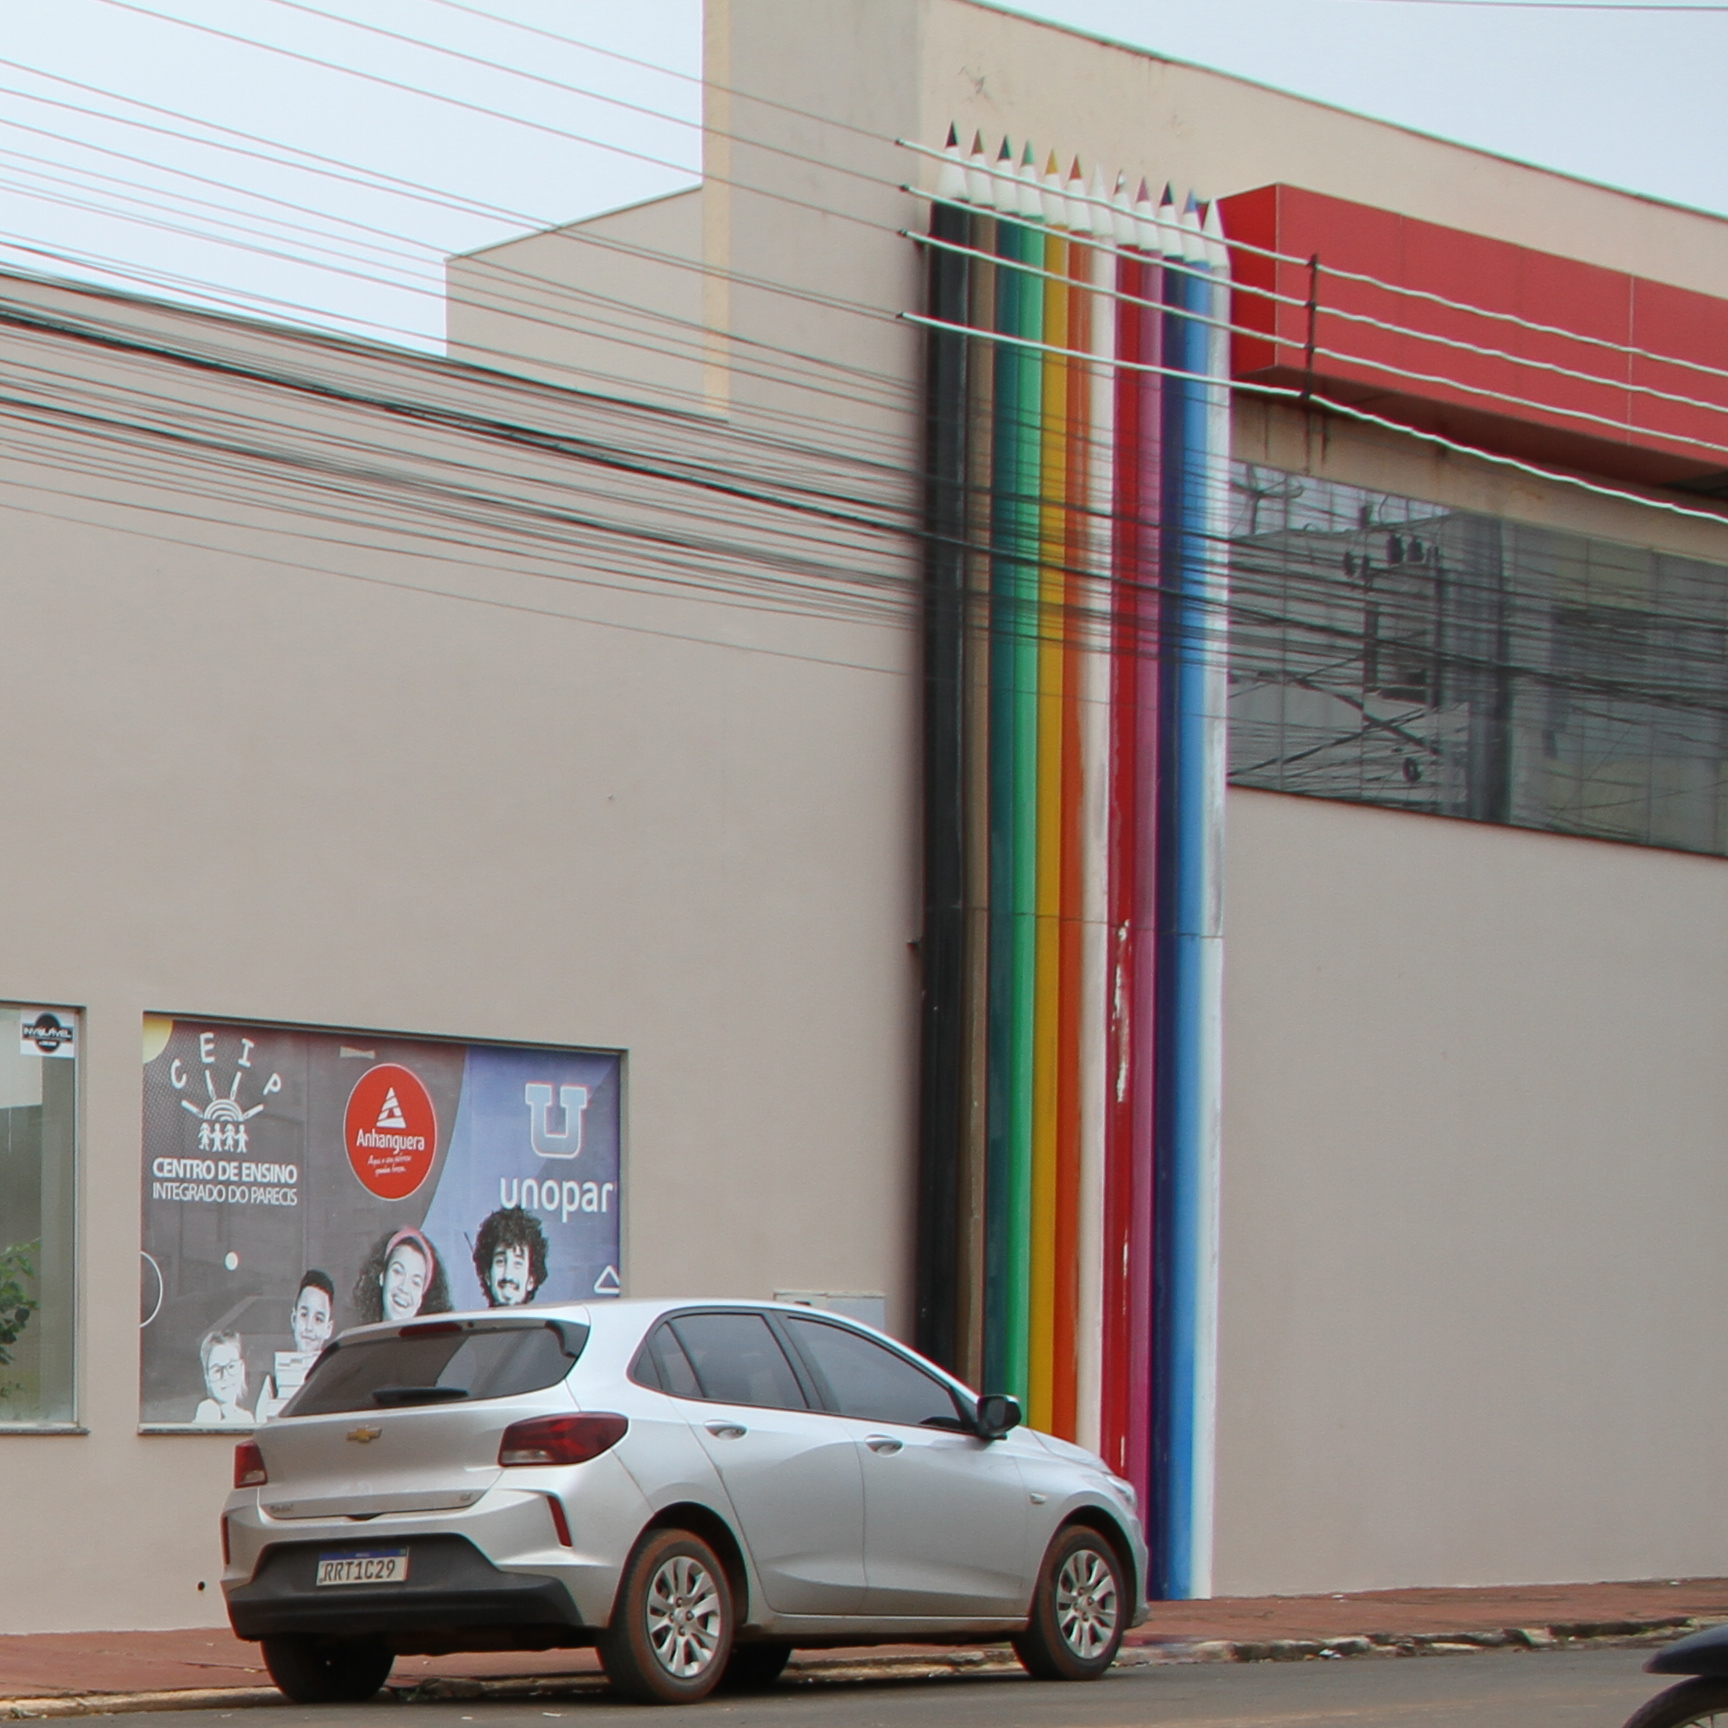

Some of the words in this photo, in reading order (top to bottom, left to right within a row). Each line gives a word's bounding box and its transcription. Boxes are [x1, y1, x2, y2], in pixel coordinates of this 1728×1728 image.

[356, 1128, 426, 1155] Anhanguera
[152, 1157, 215, 1179] CENTRO
[218, 1160, 239, 1181] DE
[241, 1161, 298, 1185] ENSINO
[152, 1181, 226, 1203] INTEGRADO
[228, 1185, 248, 1204] DO
[250, 1186, 298, 1206] PARECIS
[500, 1177, 614, 1223] unopar
[324, 1559, 396, 1581] RRT1C29
